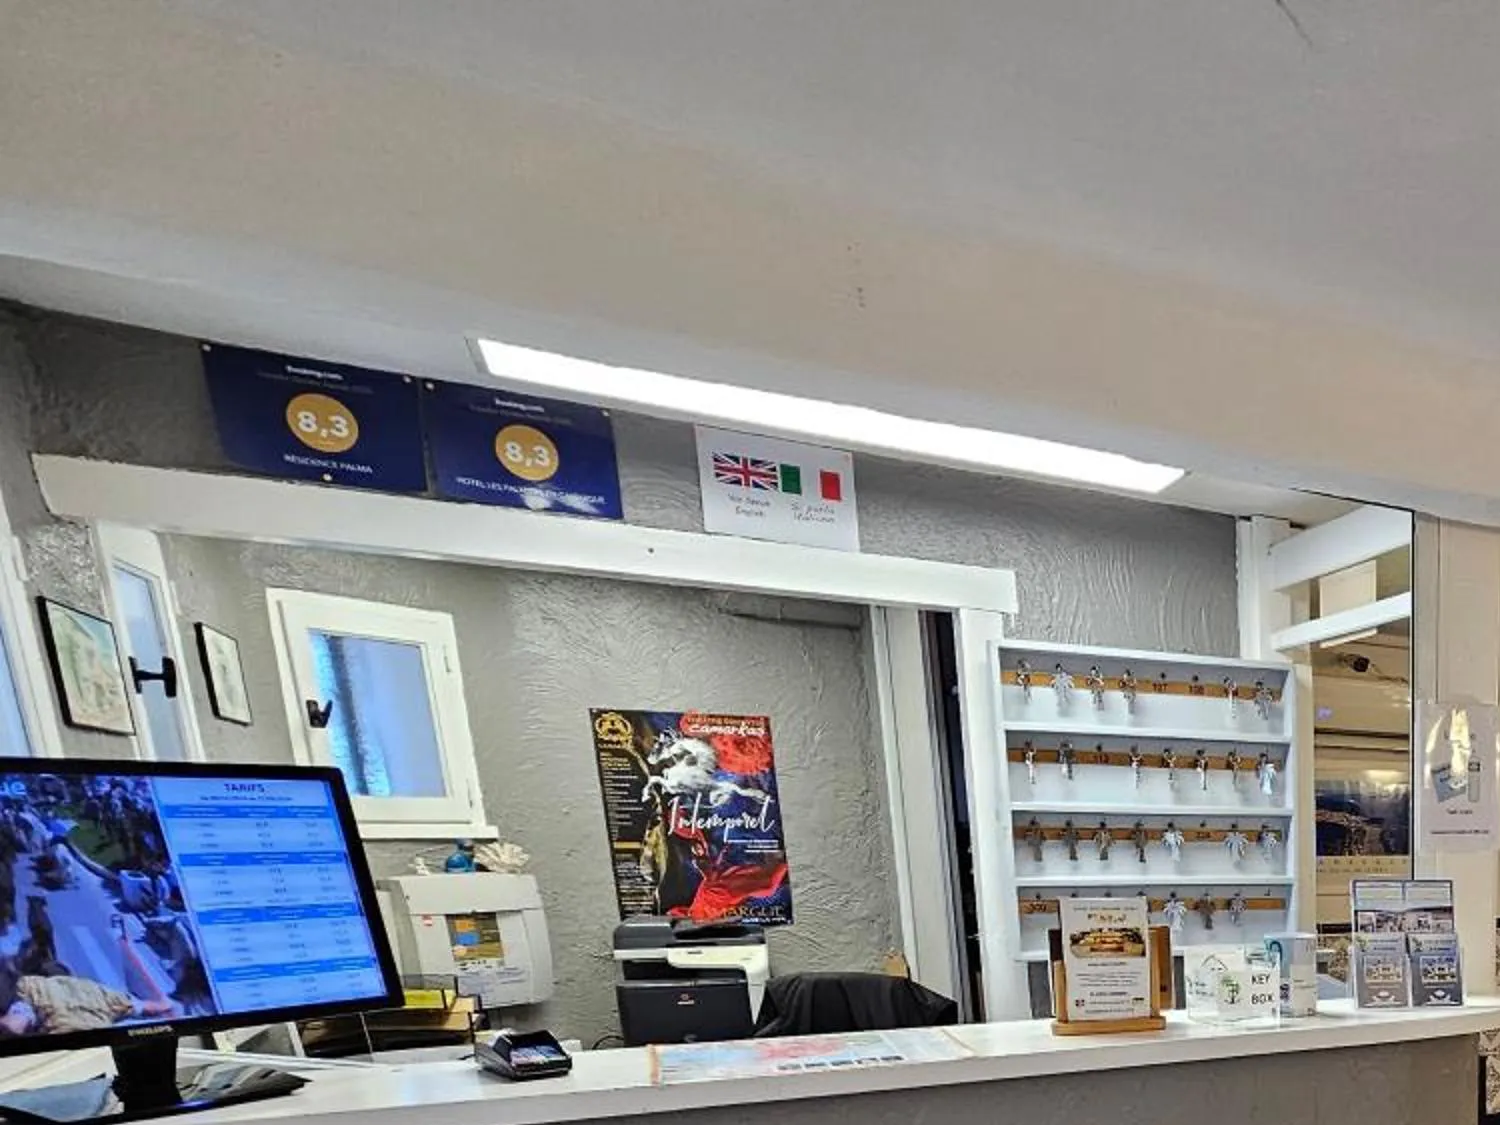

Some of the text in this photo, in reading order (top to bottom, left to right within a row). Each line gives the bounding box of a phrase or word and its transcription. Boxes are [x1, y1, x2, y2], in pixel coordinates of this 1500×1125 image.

[297, 410, 350, 439] 8,3
[505, 441, 550, 468] 8,3
[1251, 973, 1271, 986] KEY
[1250, 993, 1274, 1006] BOX
